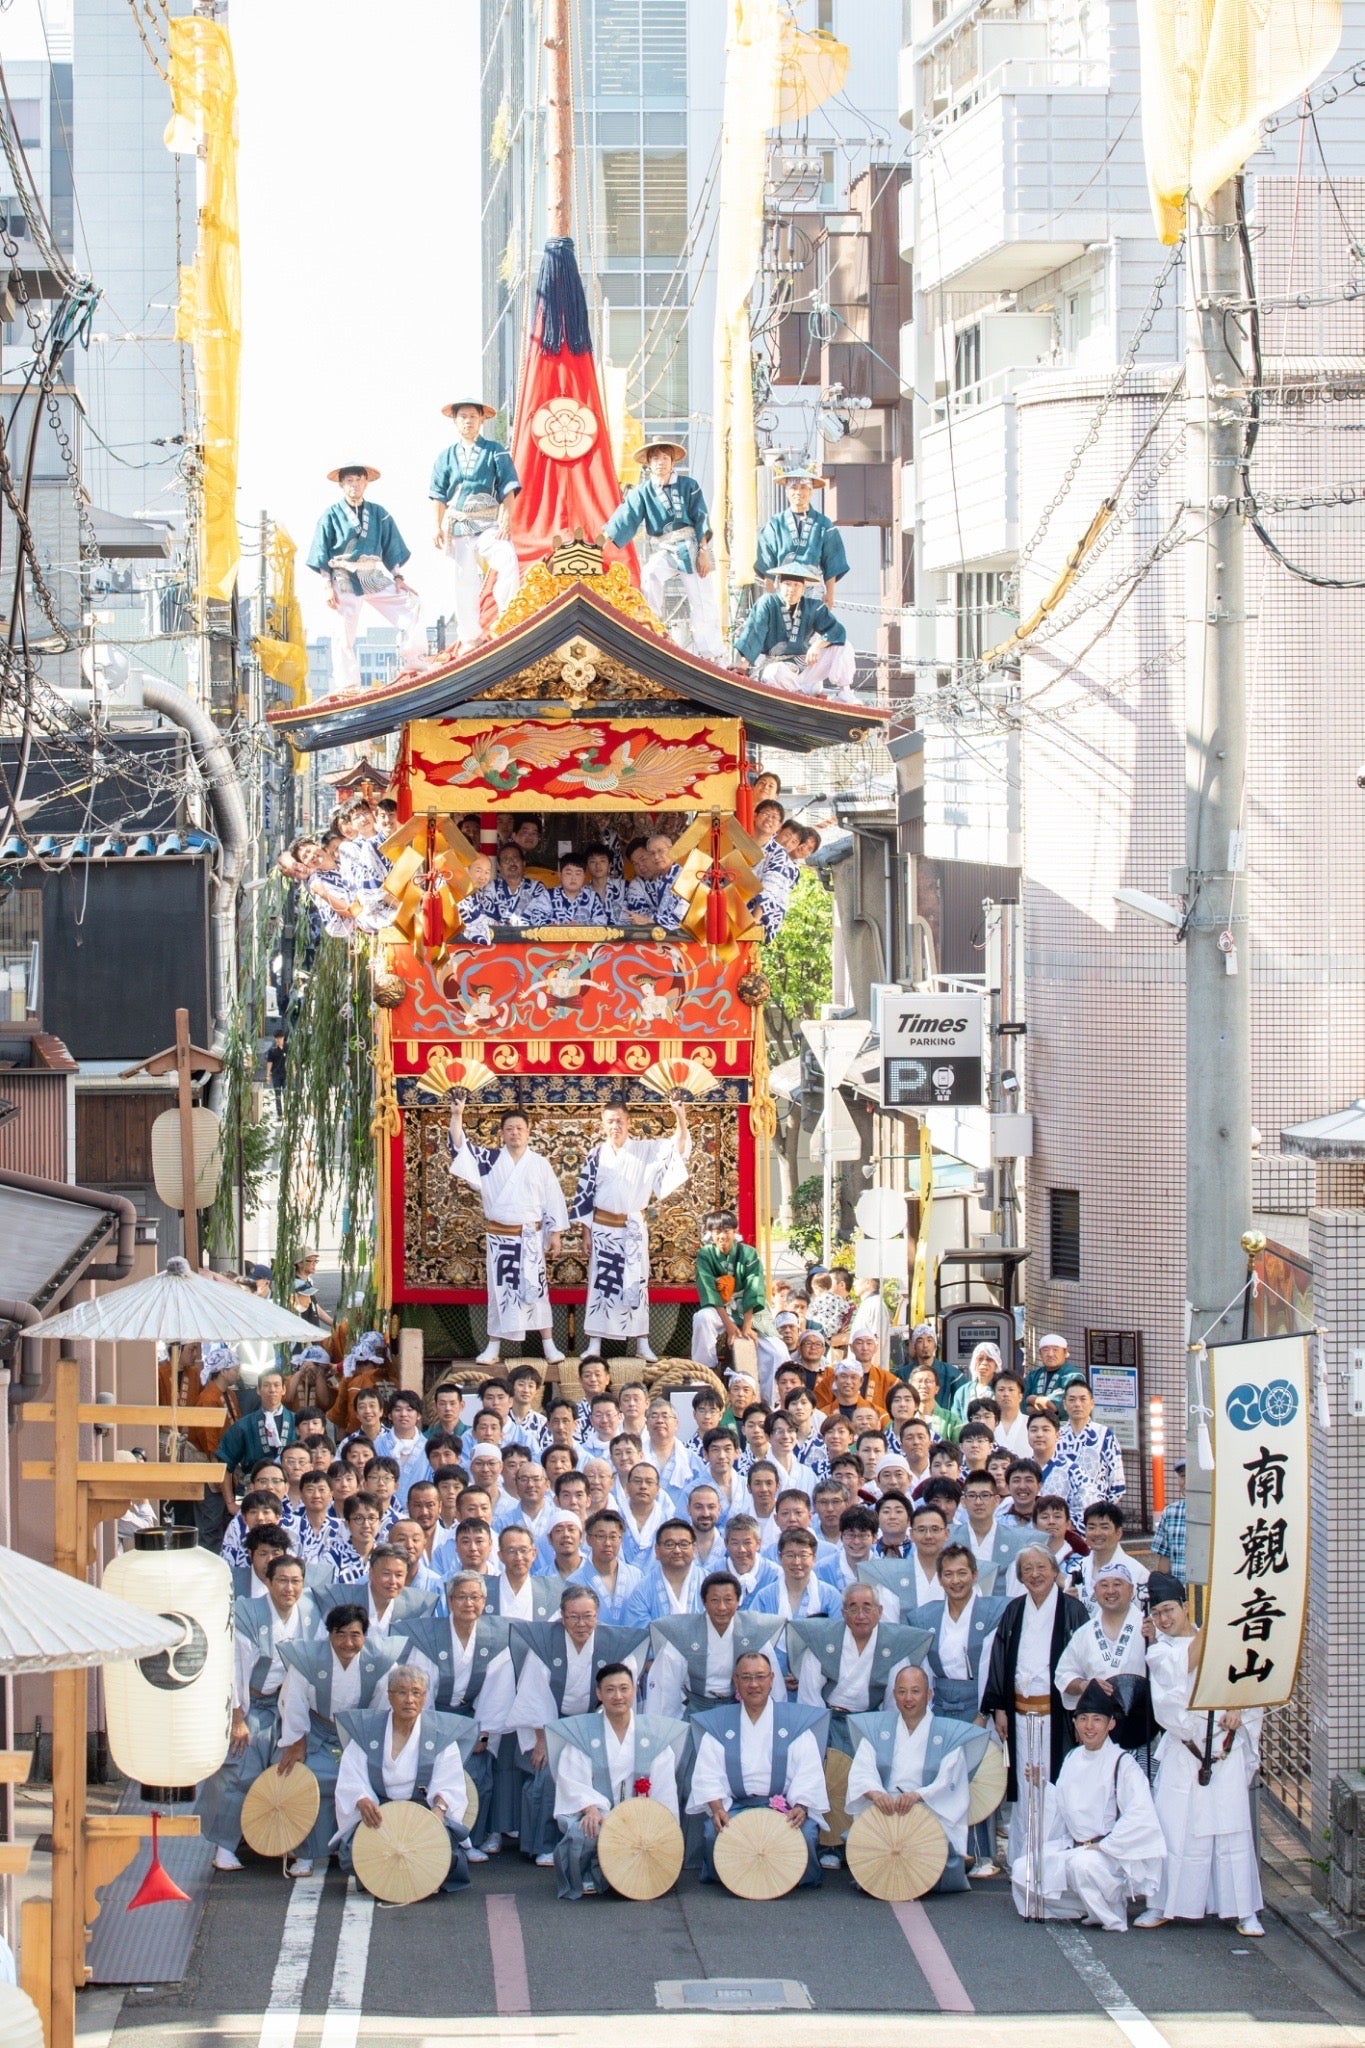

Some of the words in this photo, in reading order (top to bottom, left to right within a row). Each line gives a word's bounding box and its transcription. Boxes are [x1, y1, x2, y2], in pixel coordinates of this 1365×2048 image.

[897, 1013, 968, 1033] Times
[910, 1038, 956, 1046] PARKING
[890, 1061, 927, 1102] P
[1226, 1446, 1290, 1686] 南觀音山
